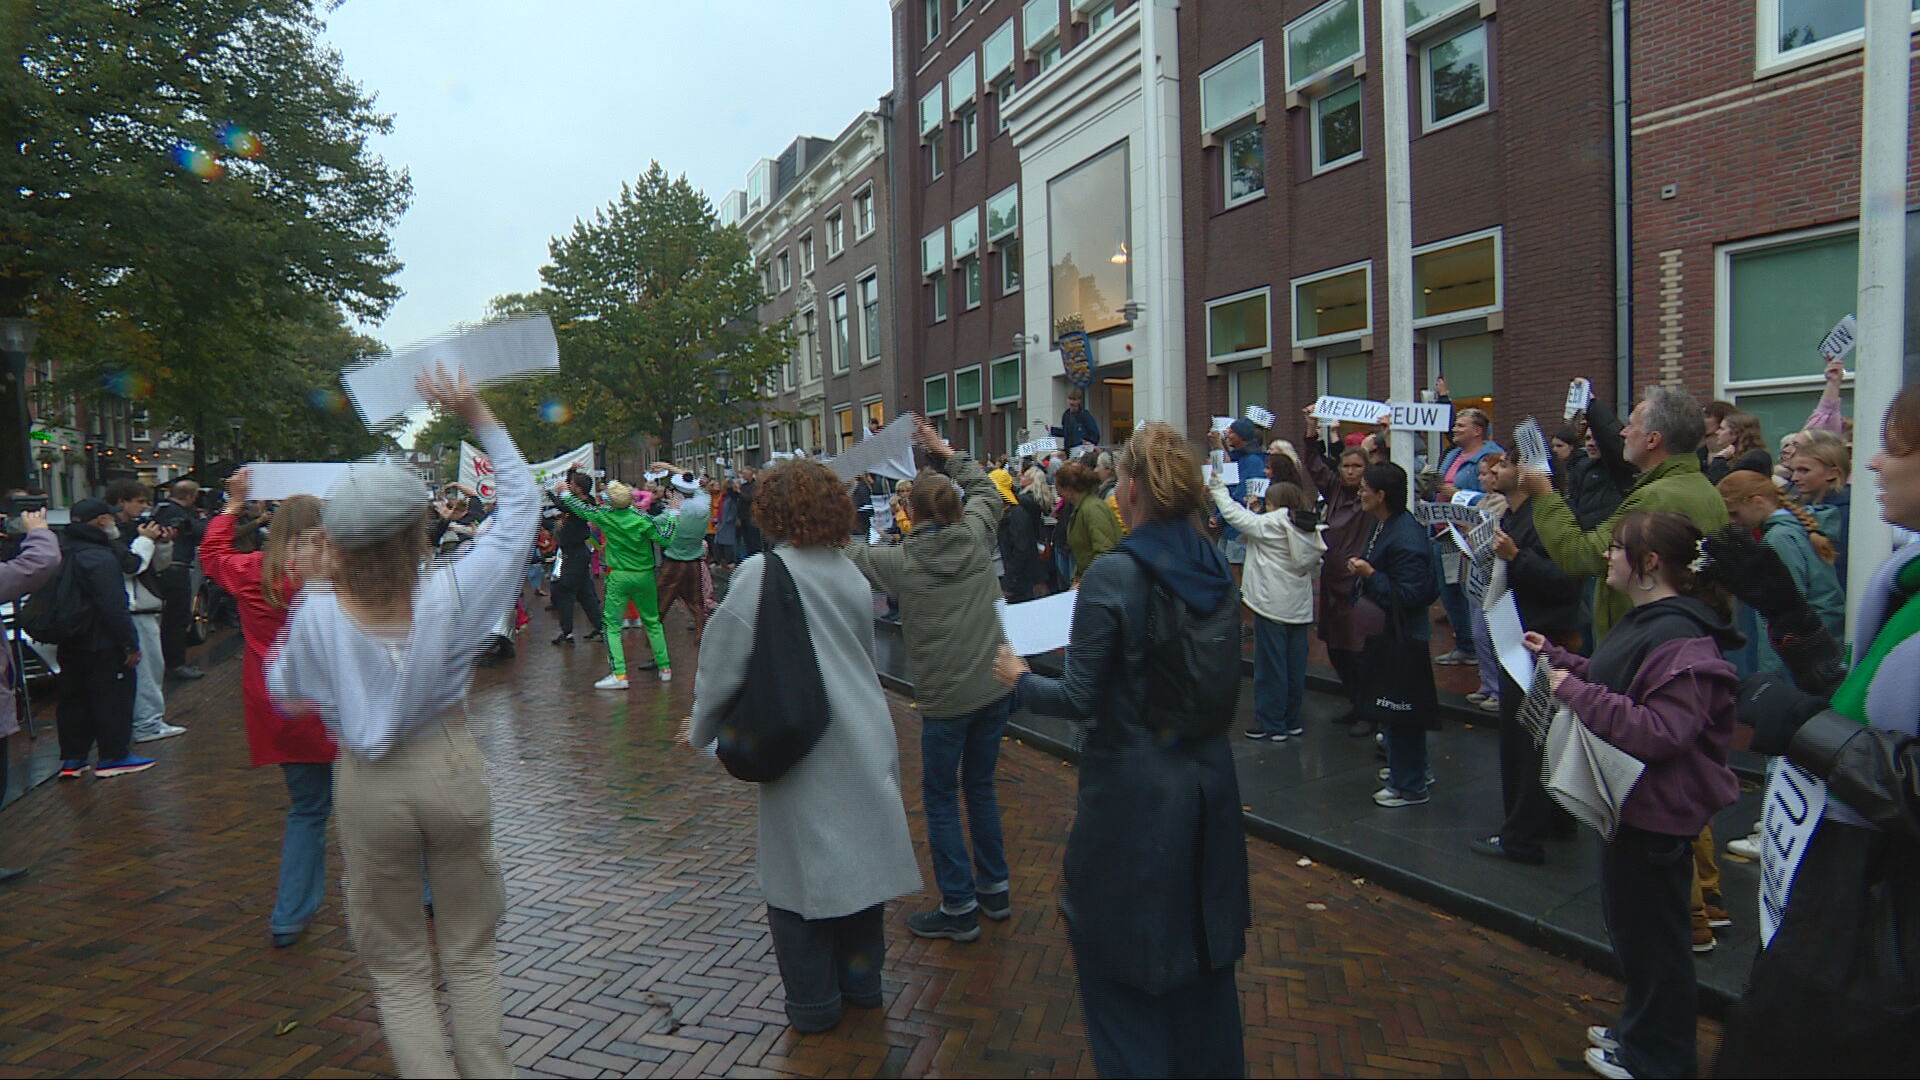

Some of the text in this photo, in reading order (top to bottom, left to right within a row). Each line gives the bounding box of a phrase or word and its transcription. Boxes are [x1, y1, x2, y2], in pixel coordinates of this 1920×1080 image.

[1318, 398, 1381, 420] MEEUW
[1391, 406, 1438, 426] EUW
[1764, 758, 1817, 929] MEEU
